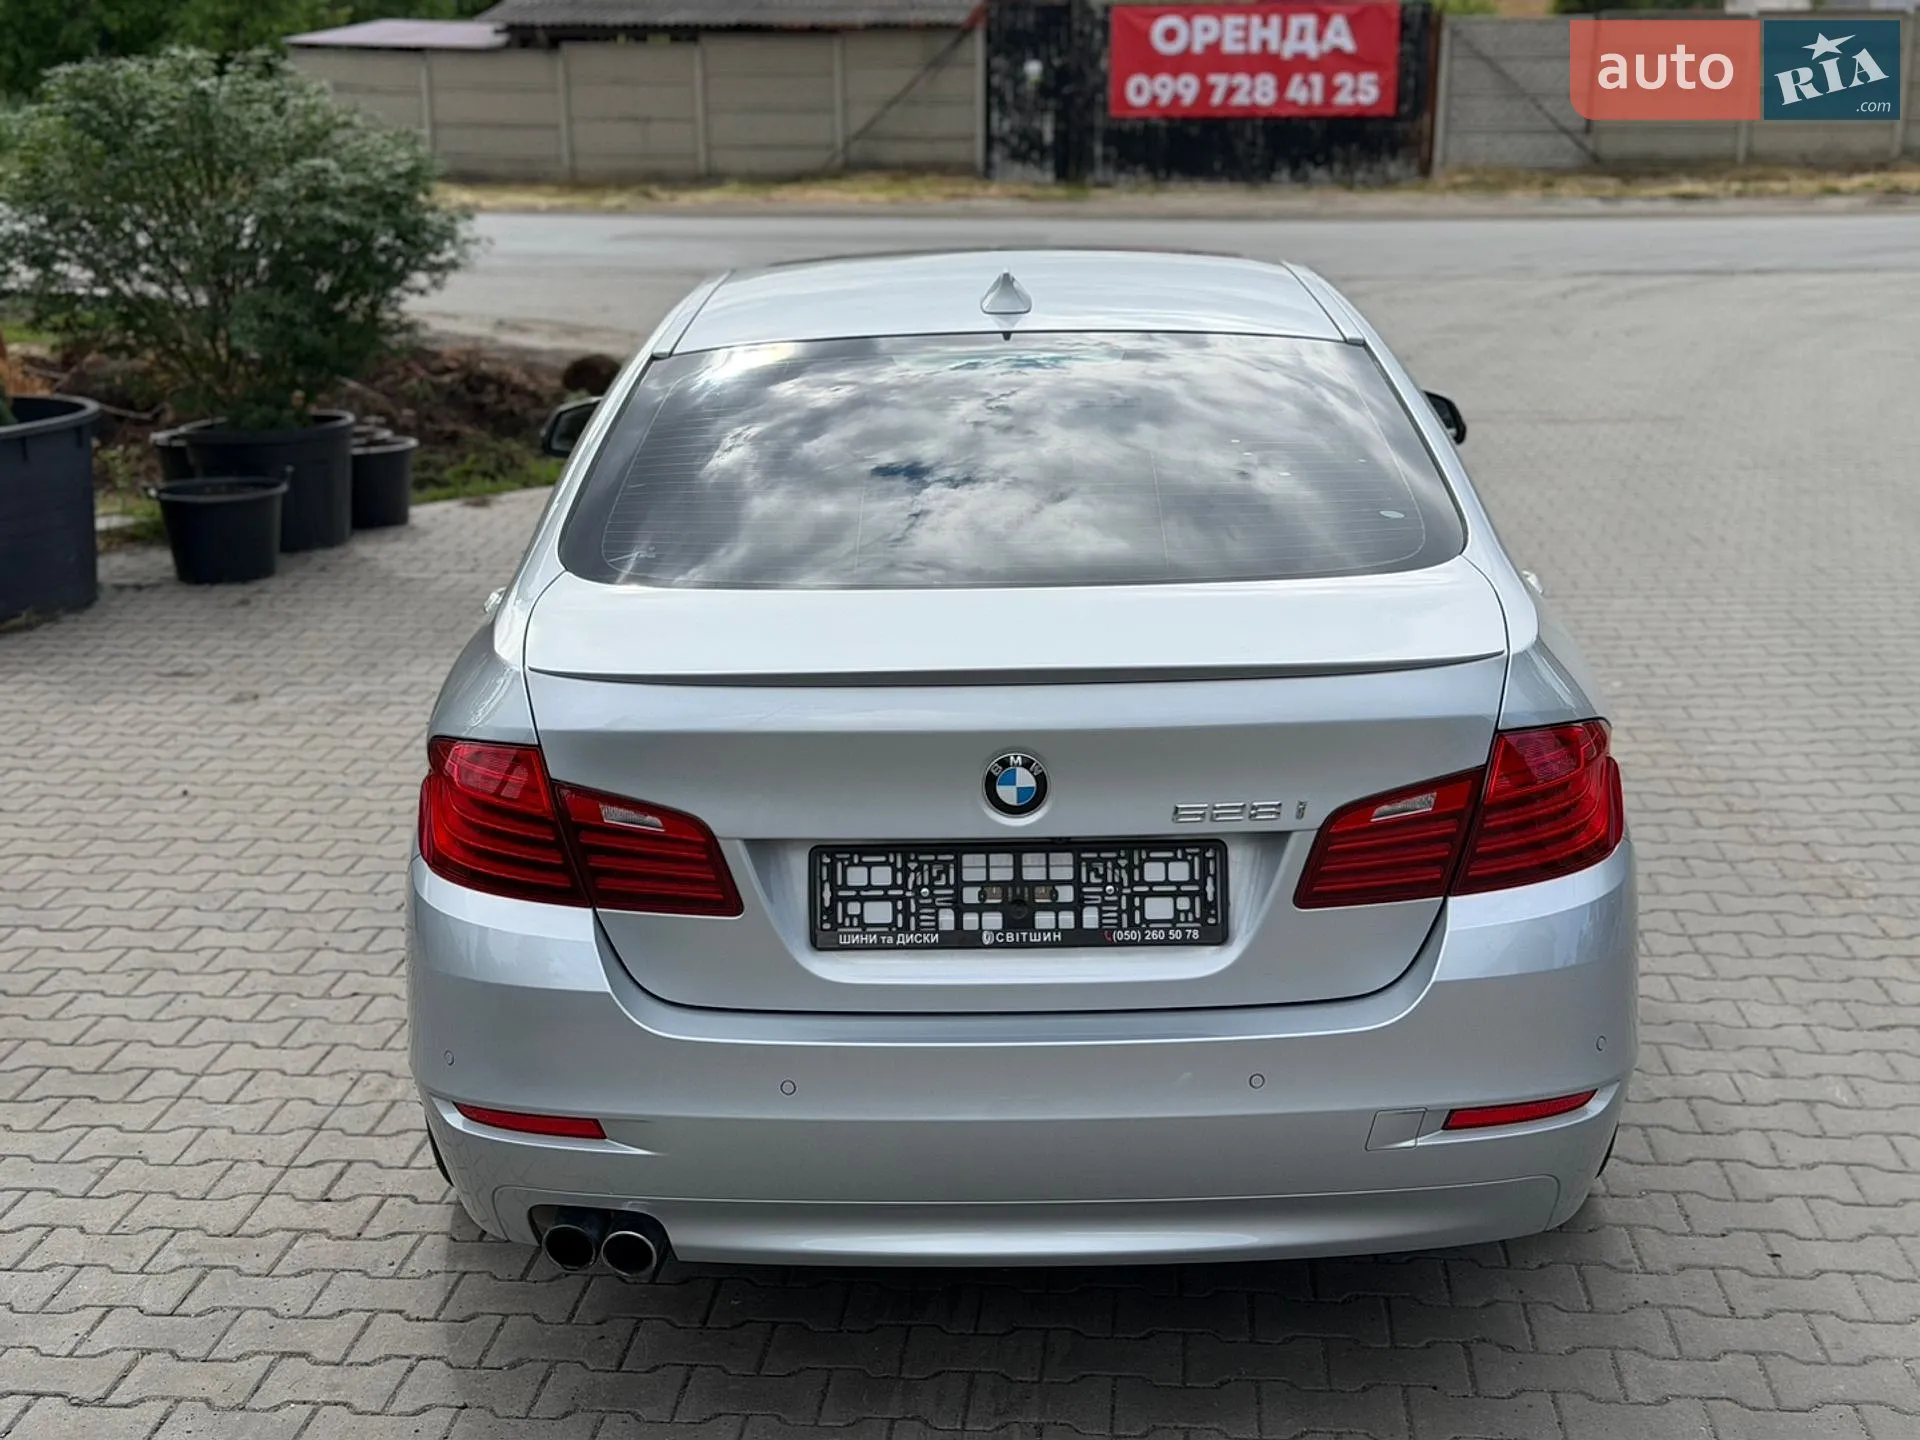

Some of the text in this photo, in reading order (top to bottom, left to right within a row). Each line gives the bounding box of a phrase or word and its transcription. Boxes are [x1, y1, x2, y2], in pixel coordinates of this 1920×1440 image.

[1150, 14, 1357, 59] ОРЕНДА
[1125, 72, 1381, 107] 099 728 41 25
[990, 755, 1043, 777] BMW
[838, 933, 939, 946] ШИНИ та ДИСКИ
[995, 931, 1062, 943] СВІТШИН
[1112, 929, 1200, 942] (050) 260 50 78
